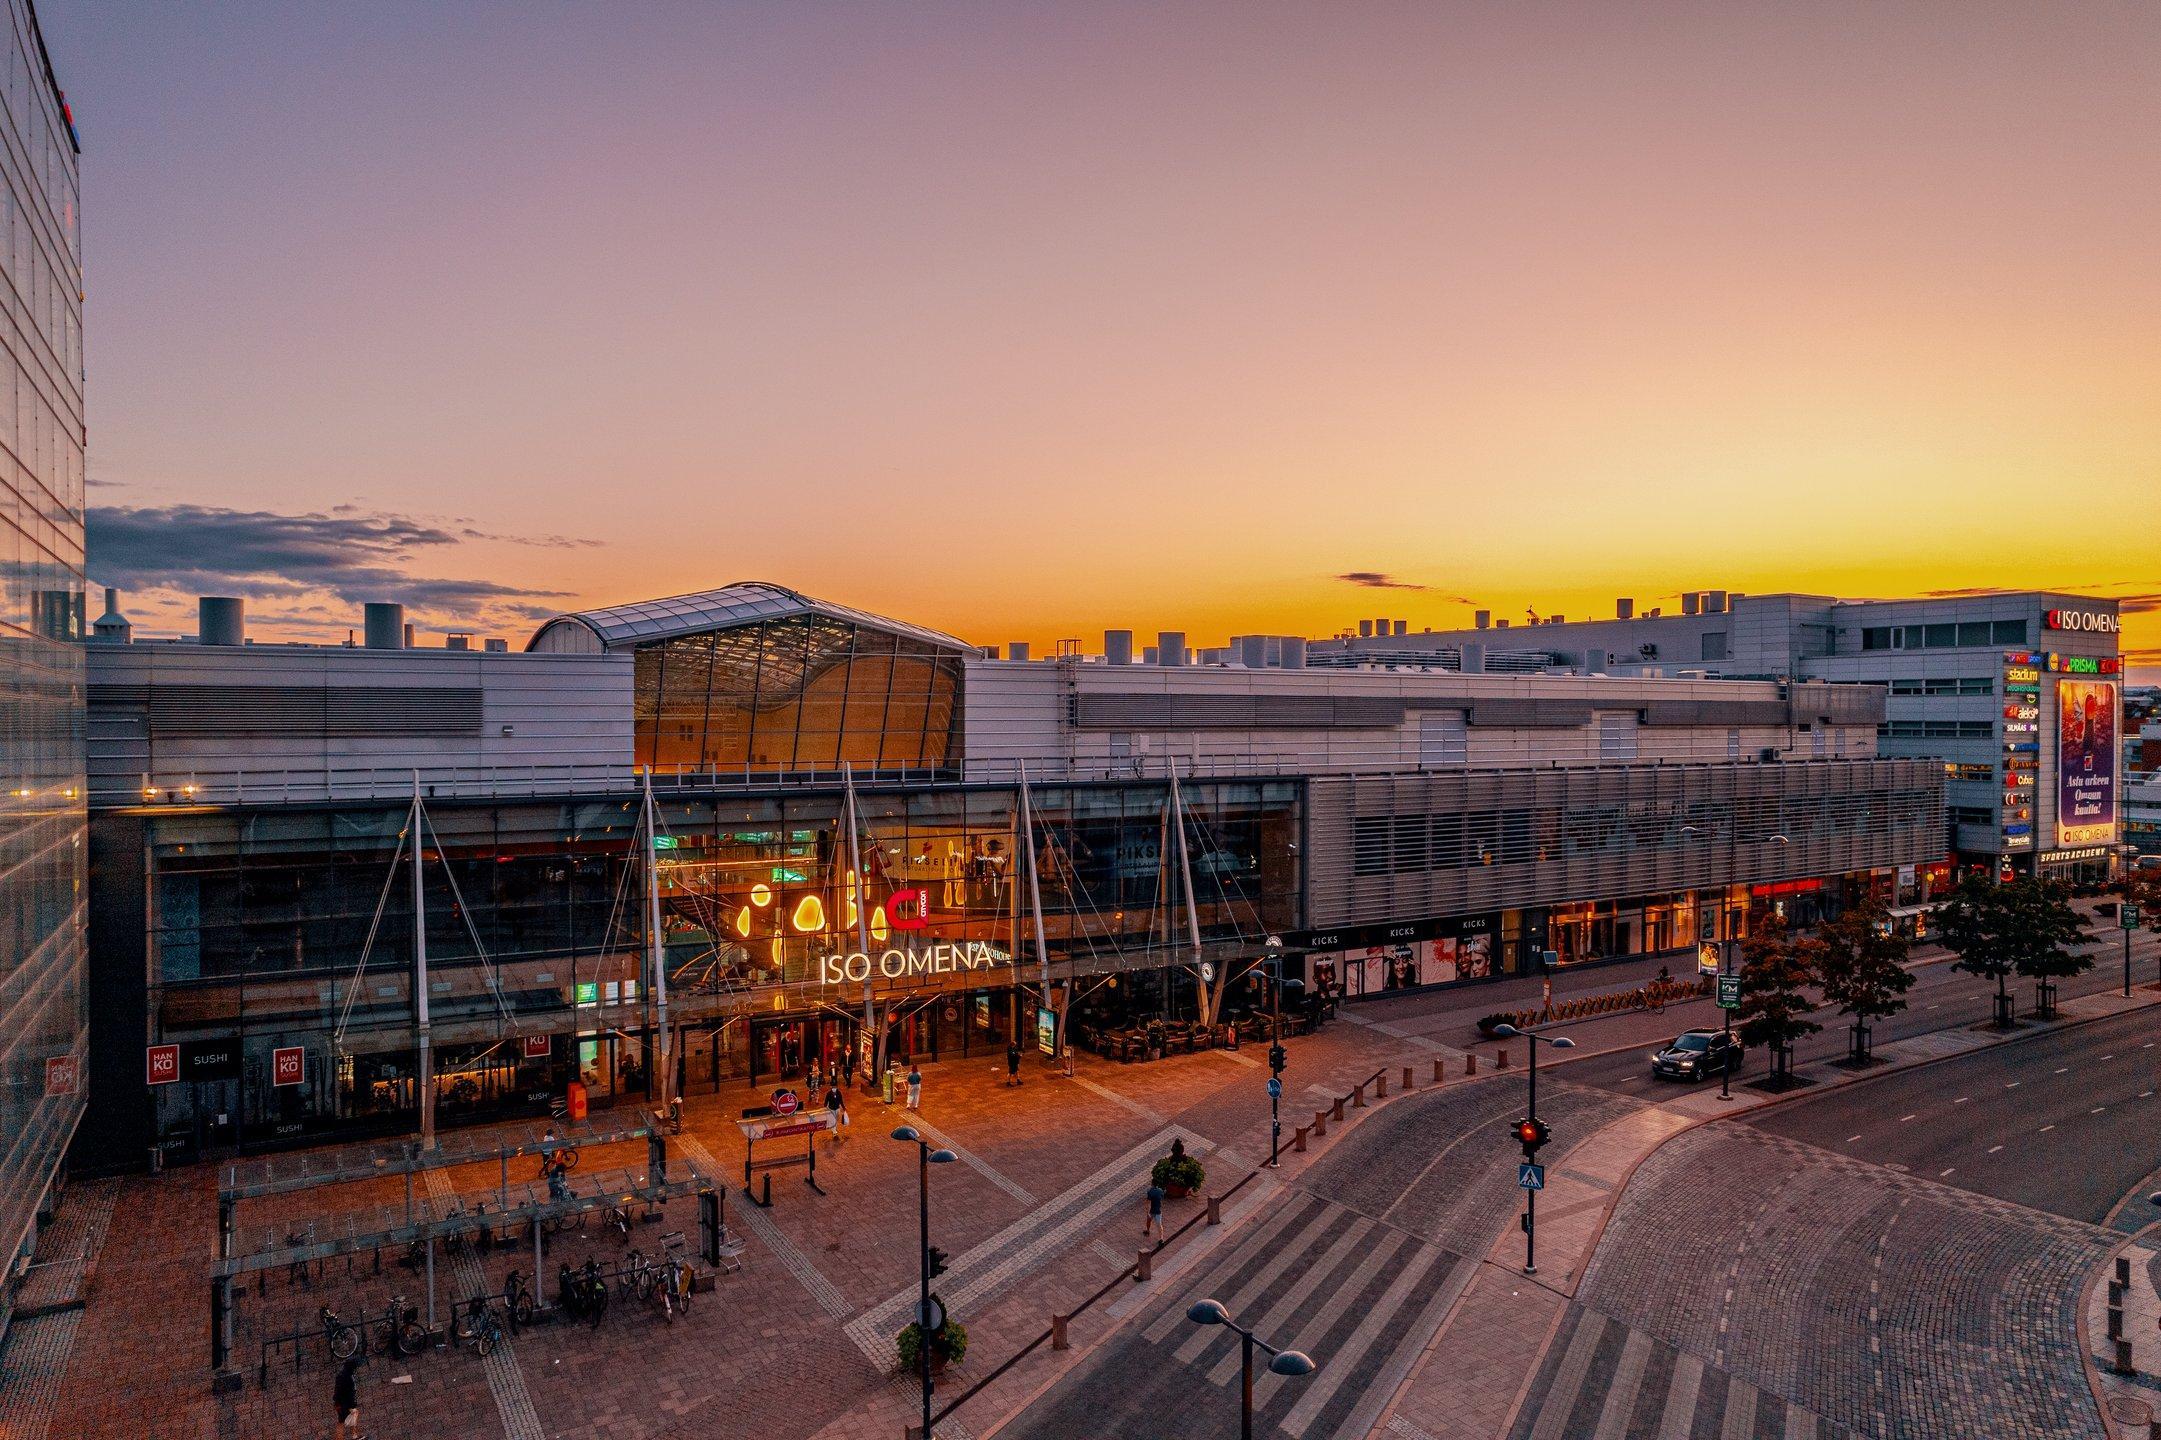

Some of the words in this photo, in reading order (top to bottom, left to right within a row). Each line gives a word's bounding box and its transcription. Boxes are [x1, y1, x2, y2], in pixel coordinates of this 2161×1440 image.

[2062, 611, 2080, 630] ISO
[2083, 612, 2121, 632] OMENA
[2070, 658, 2097, 673] PRISMA
[2009, 668, 2038, 681] stadium
[2017, 774, 2034, 785] Cubus
[2041, 851, 2070, 862] SPORTS
[2070, 847, 2106, 859] ACADEMY
[1463, 919, 1486, 929] KICKS
[1390, 927, 1415, 937] KICKS
[1311, 935, 1338, 946] KICKS
[820, 952, 871, 985] ISO
[881, 940, 994, 978] OMENA
[530, 1035, 545, 1045] KO
[154, 1053, 173, 1061] HAN
[194, 1053, 228, 1065] SUSHI
[154, 1059, 173, 1071] KO
[280, 1061, 298, 1073] KO
[276, 1124, 303, 1134] SUSHI
